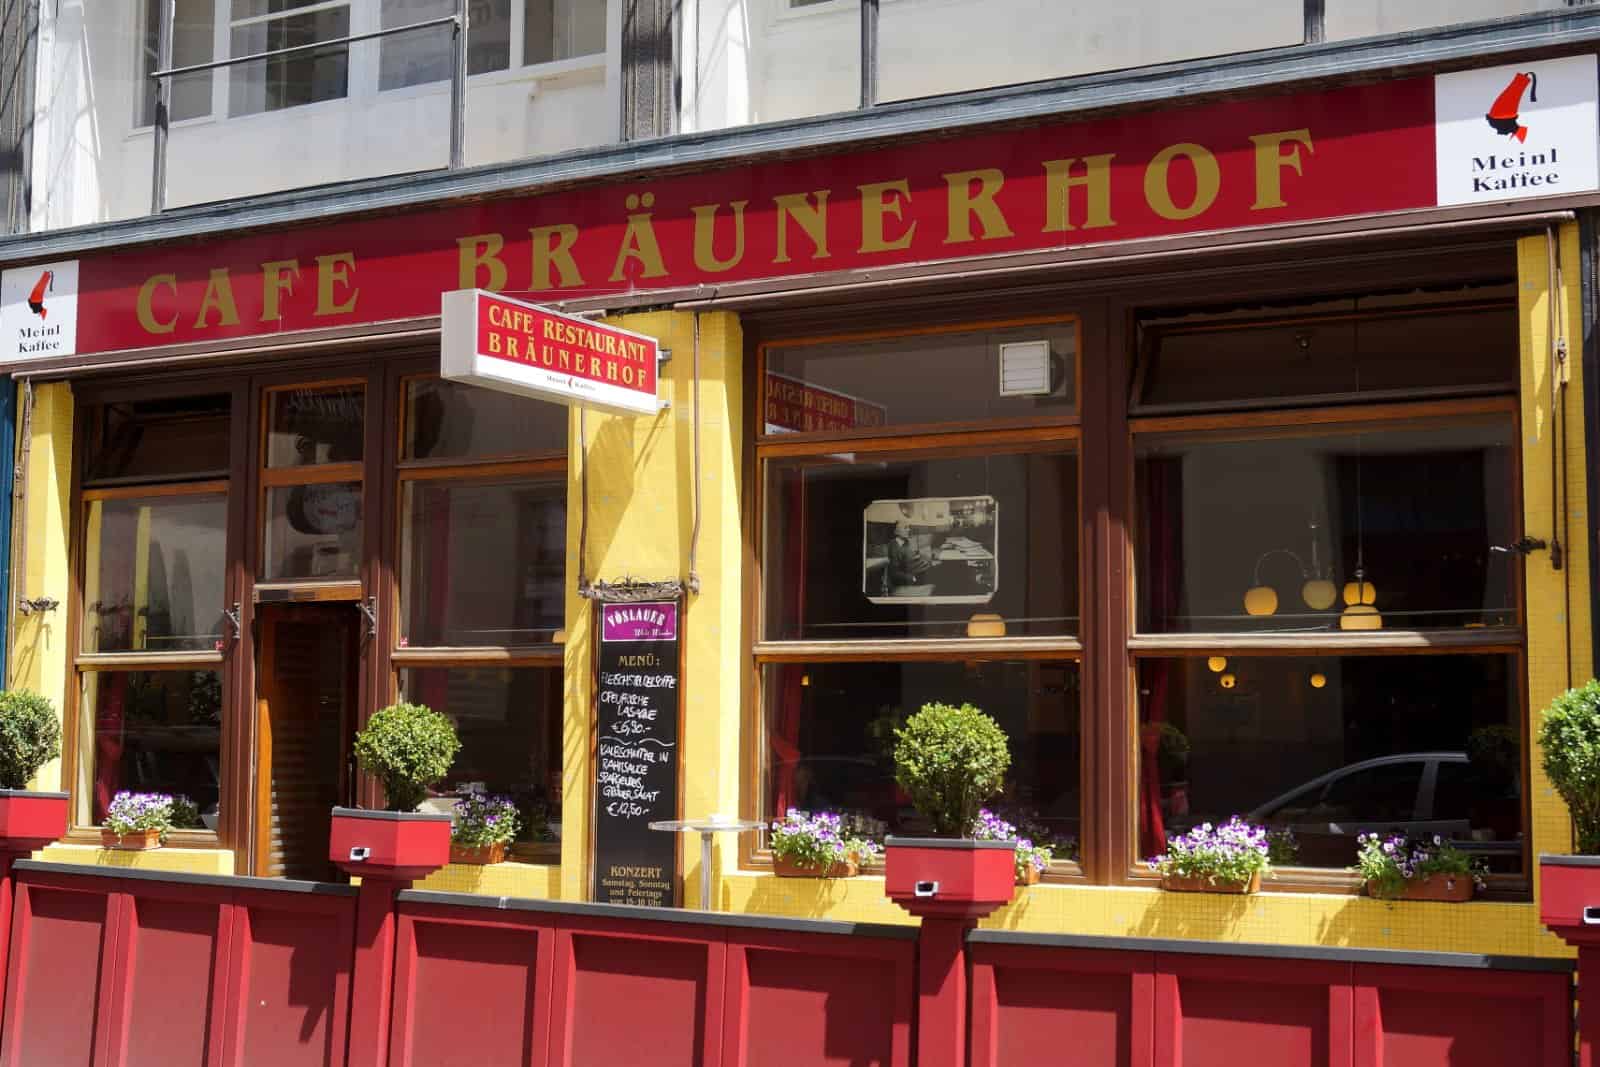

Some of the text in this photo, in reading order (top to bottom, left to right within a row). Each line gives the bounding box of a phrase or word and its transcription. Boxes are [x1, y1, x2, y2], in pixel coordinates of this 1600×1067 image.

[1472, 148, 1558, 172] Meinl
[1472, 171, 1560, 193] Kaffee
[136, 128, 1316, 334] CAFE BRÄUNERHOF
[19, 324, 60, 338] Meinl
[488, 305, 647, 363] CAFE RESTAURANT
[19, 340, 60, 353] Kaffee
[488, 332, 647, 387] BRÄUNERHOF
[610, 864, 663, 879] KONZERT
[609, 888, 625, 897] und
[639, 879, 671, 891] Sonntag
